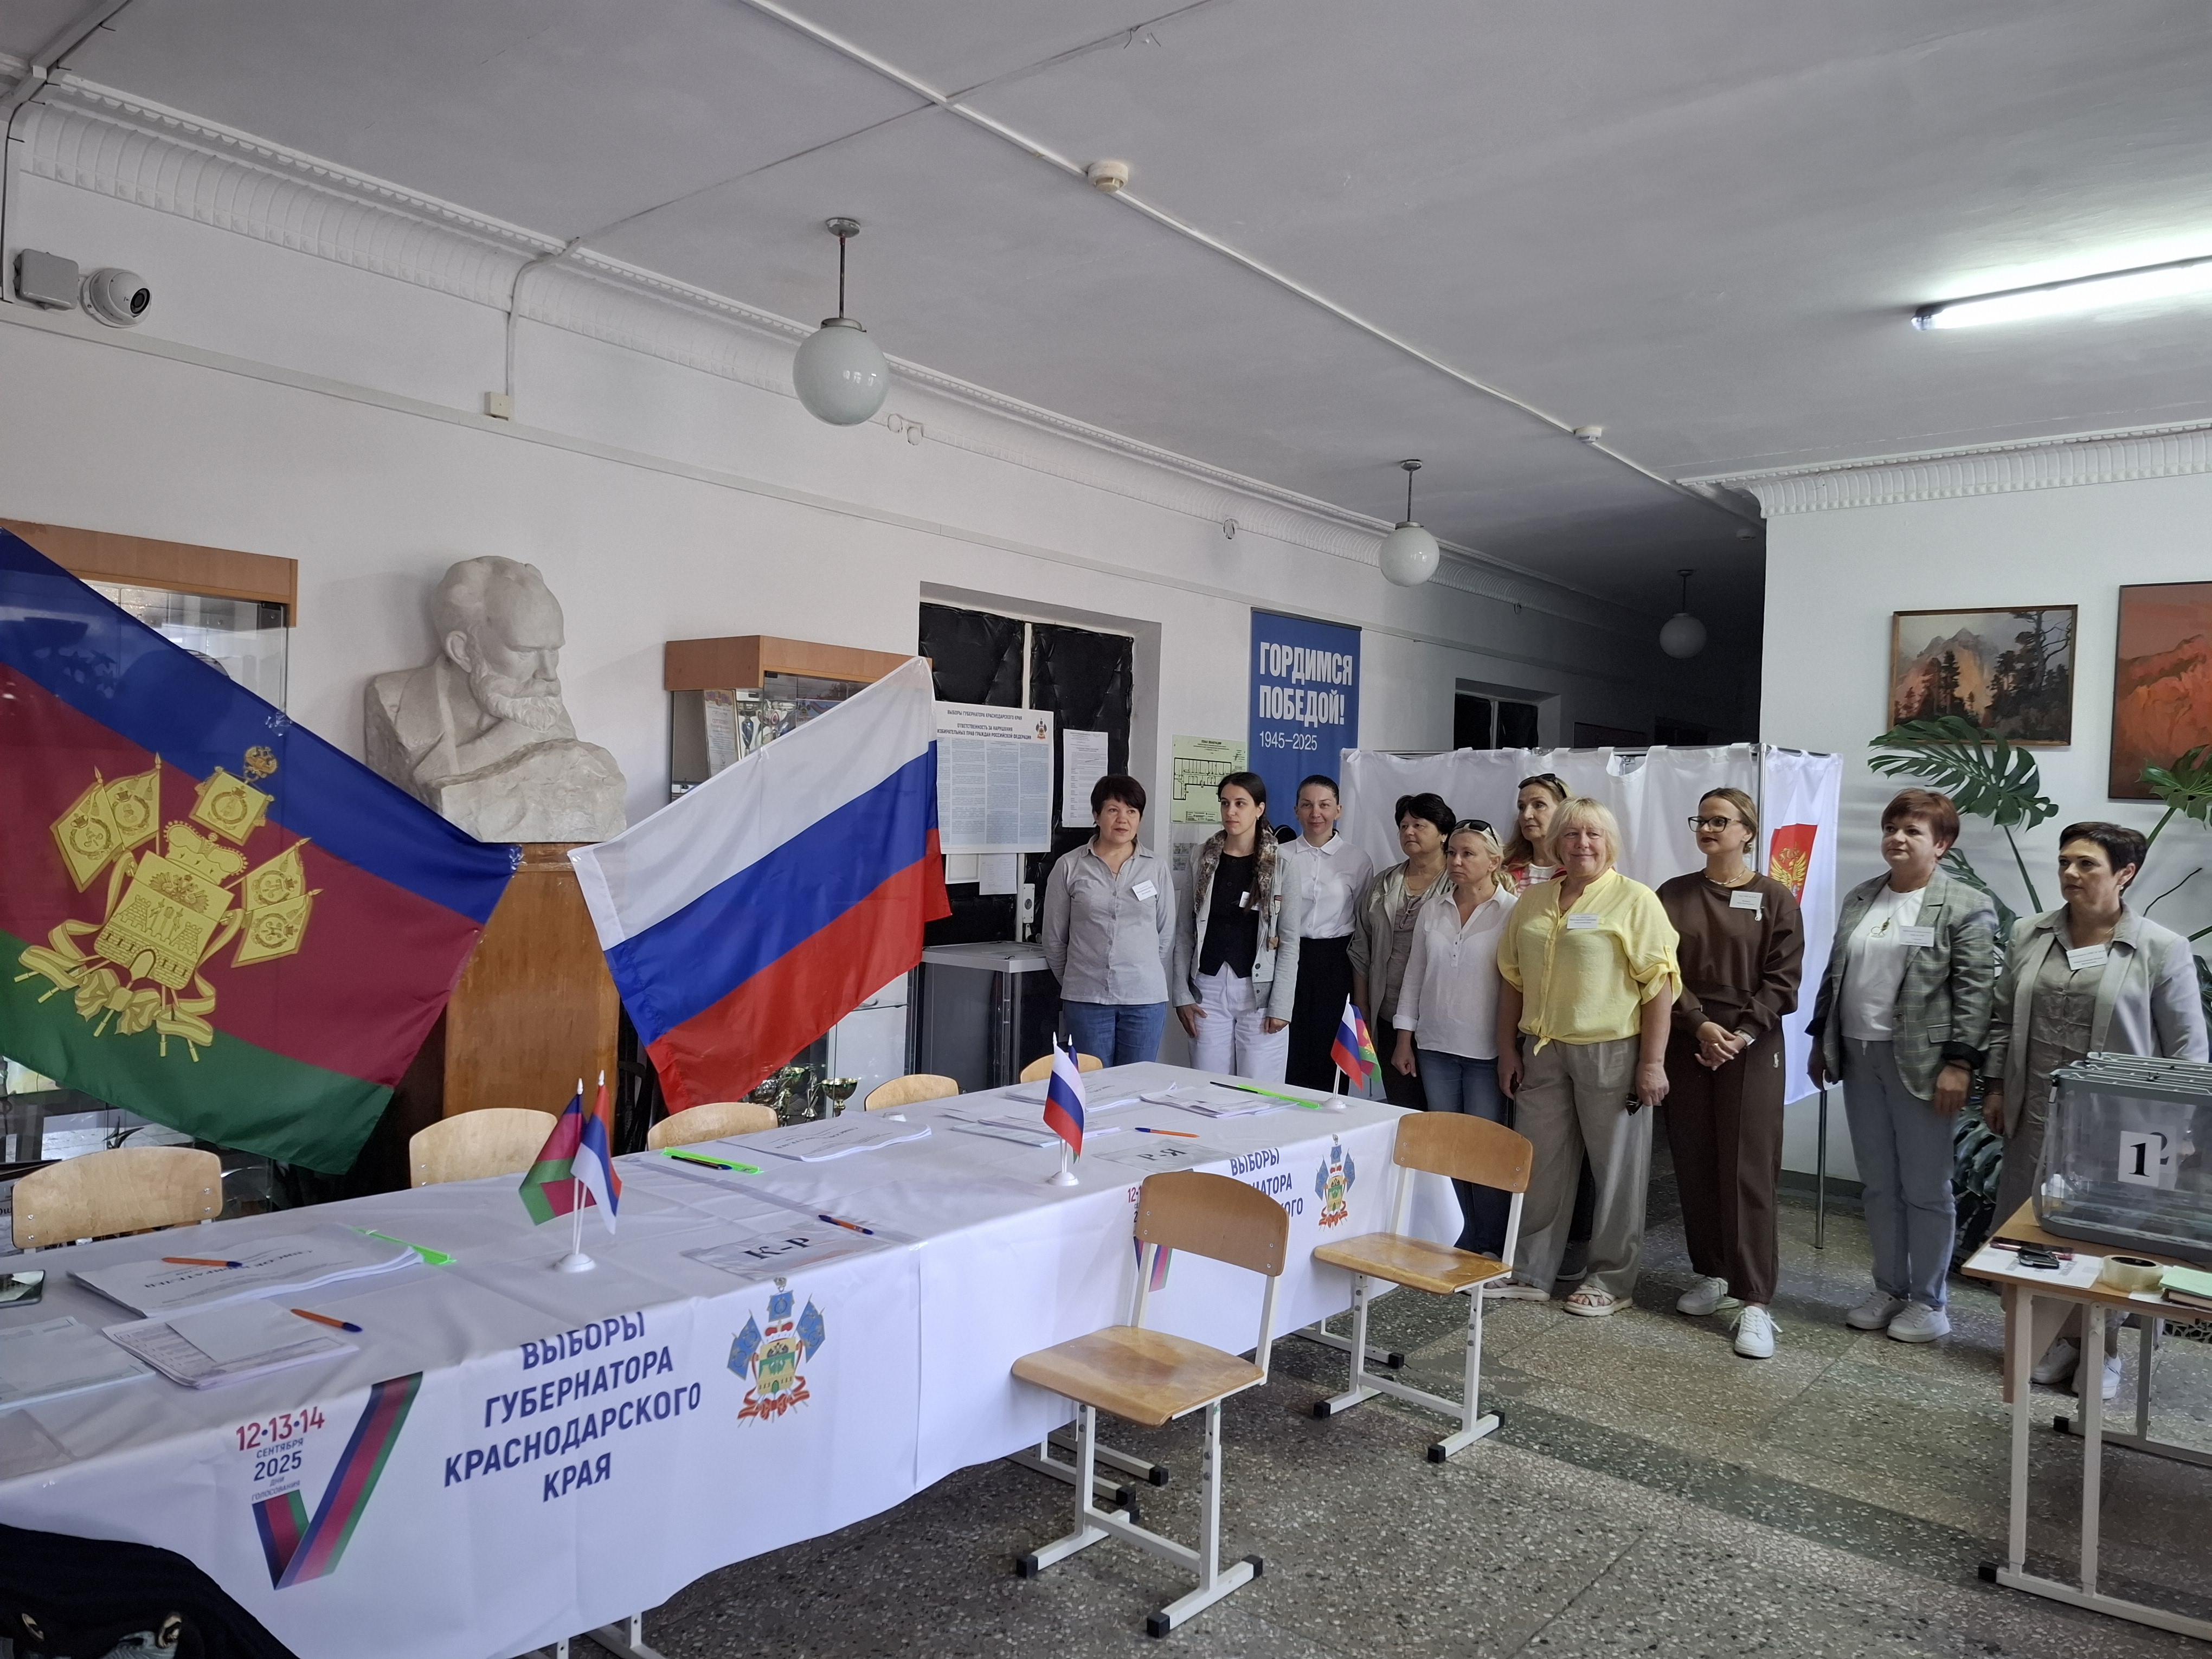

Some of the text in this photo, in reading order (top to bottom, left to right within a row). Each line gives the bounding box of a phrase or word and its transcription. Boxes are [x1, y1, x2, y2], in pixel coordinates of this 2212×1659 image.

[1259, 641, 1353, 686] ГОРДИМСЯ
[1259, 685, 1345, 728] ПОБЕДОЙ!
[1229, 1147, 1279, 1176] ВЫБОРЫ
[2128, 1142, 2150, 1178] 1
[738, 1237, 813, 1259] К-Р
[519, 1311, 645, 1371] ВЫБОРЫ
[484, 1345, 673, 1429] ГУБЕРНАТОРА
[256, 1437, 304, 1459] СЕНТЯБРЯ
[444, 1382, 701, 1488] КРАСНОДАРСКОГО
[253, 1450, 302, 1482] 2025
[269, 1476, 285, 1488] ДНИ
[543, 1451, 612, 1503] КРАЯ
[251, 1480, 301, 1501] ГОЛОСОВАНИЯ
